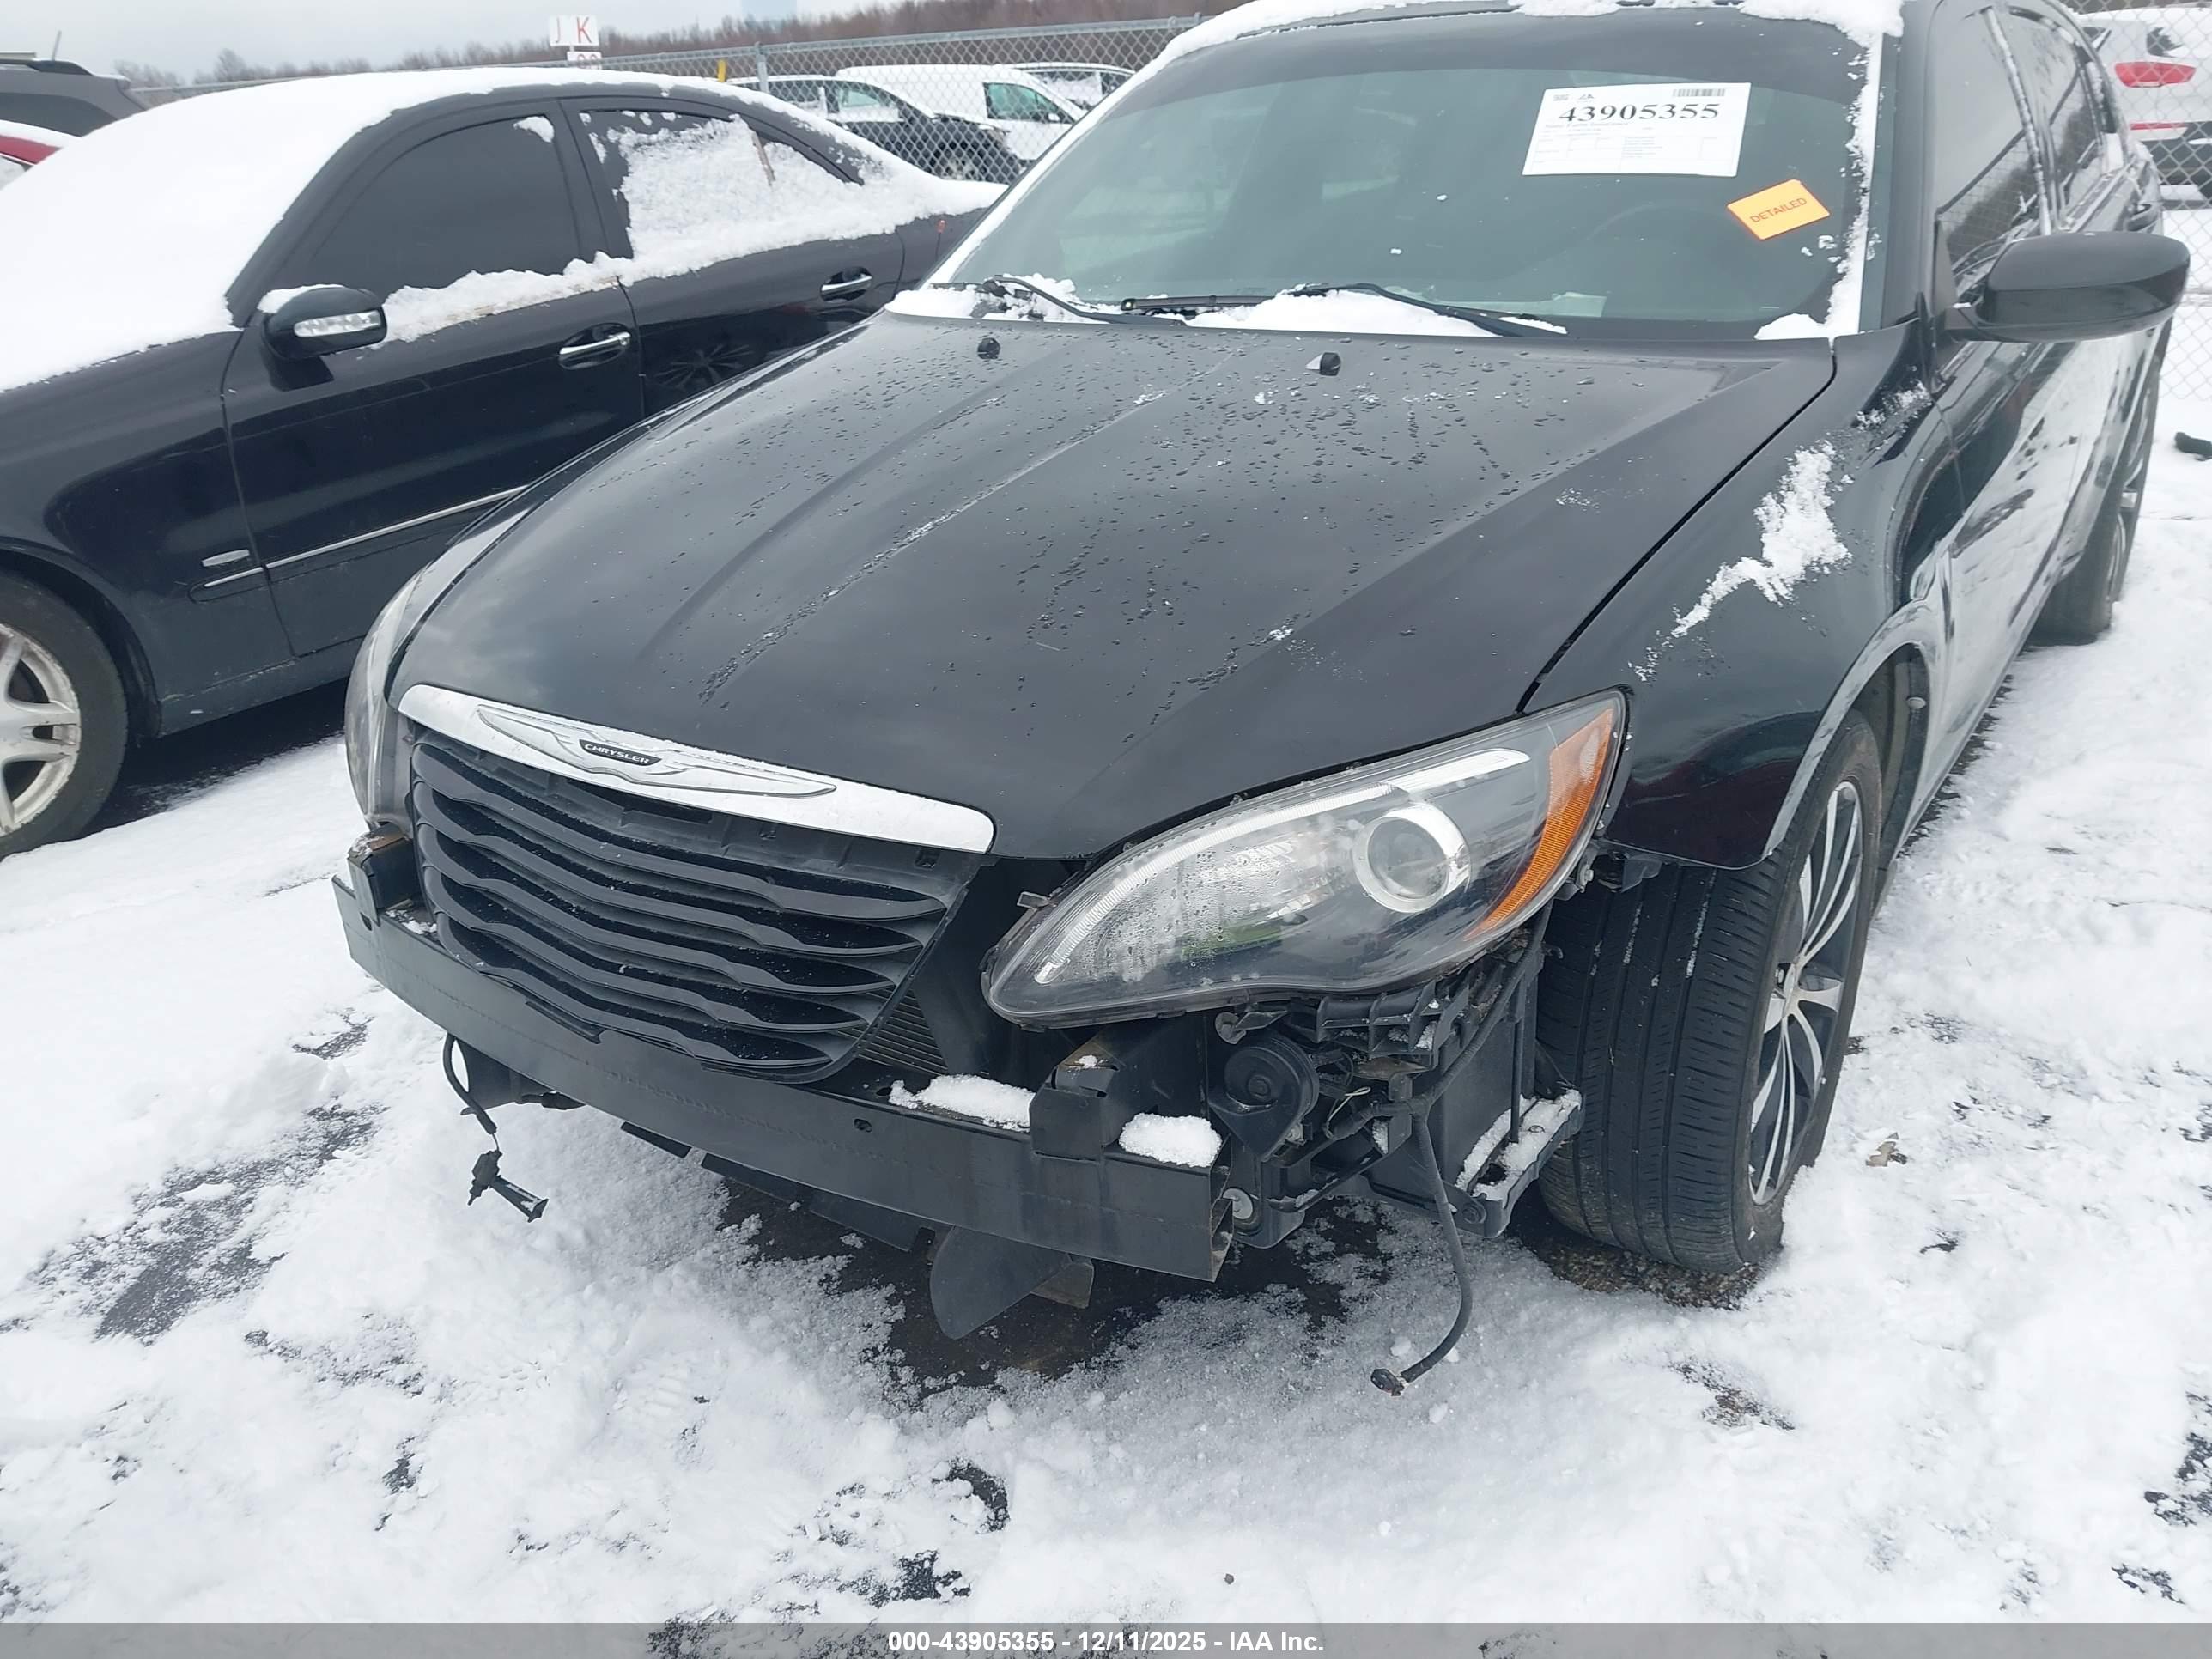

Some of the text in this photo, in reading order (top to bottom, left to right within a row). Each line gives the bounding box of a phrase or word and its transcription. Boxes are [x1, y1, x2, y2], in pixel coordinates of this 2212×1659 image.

[576, 16, 592, 44] K
[1559, 103, 1721, 122] 43905355
[1749, 198, 1808, 223] DETAILED
[584, 744, 651, 764] CHRYSLER
